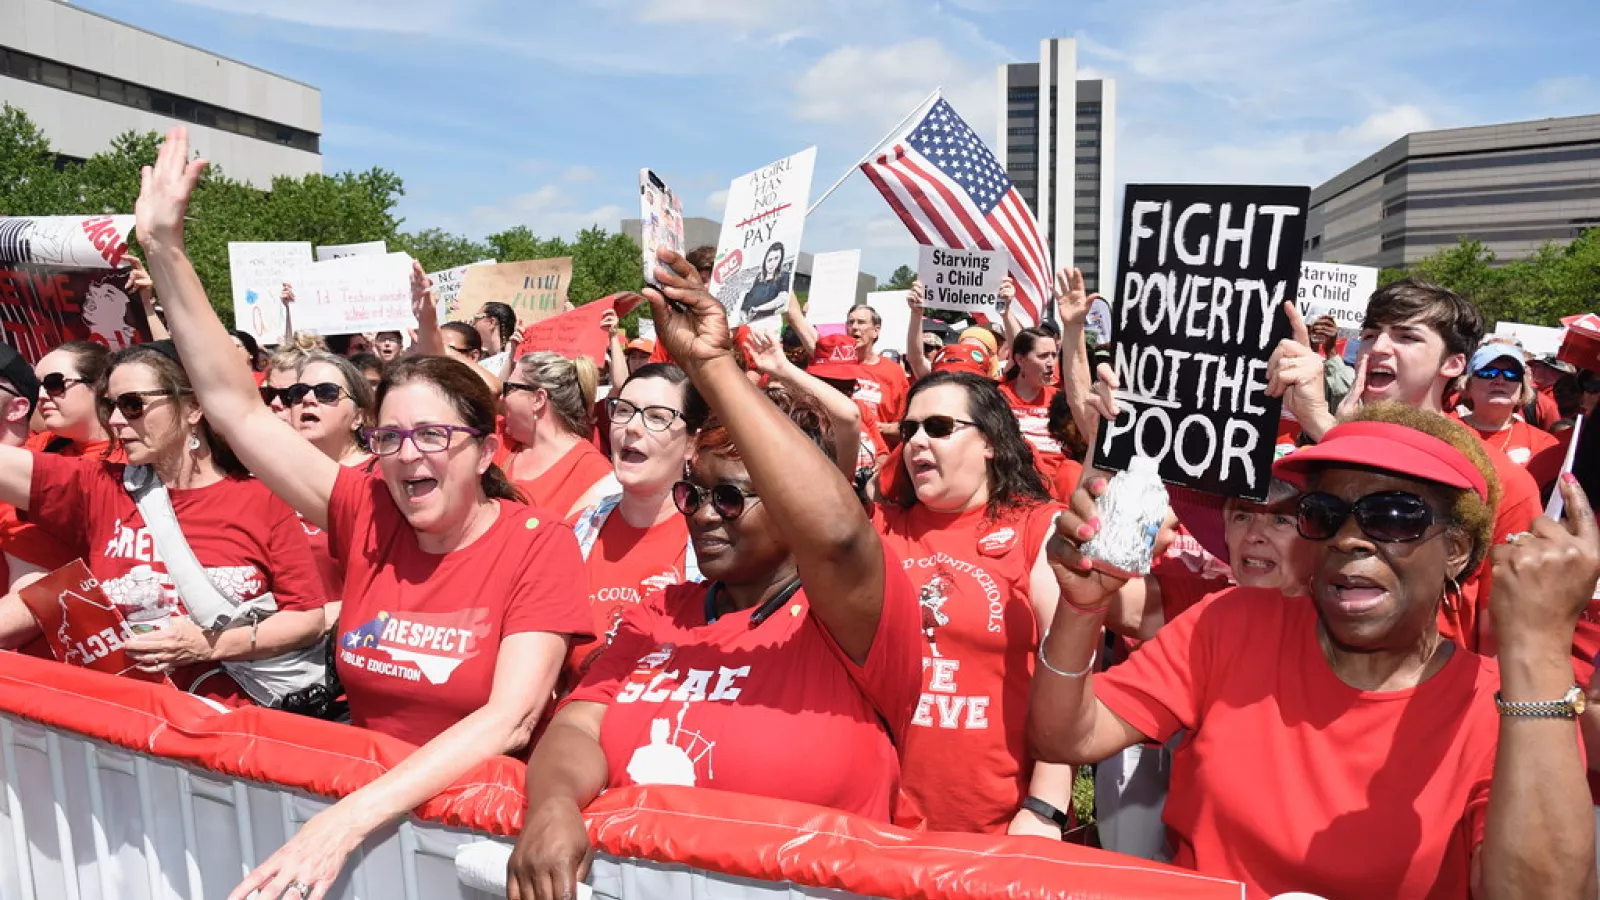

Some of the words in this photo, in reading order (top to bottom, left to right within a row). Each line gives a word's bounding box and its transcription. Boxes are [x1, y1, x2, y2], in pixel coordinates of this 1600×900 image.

[762, 158, 793, 179] GIRL
[754, 178, 782, 197] HAS
[754, 191, 777, 211] NO
[743, 220, 777, 249] PAY
[1129, 200, 1300, 271] FIGHT
[933, 249, 990, 272] Starving
[33, 273, 80, 313] ME
[936, 271, 944, 284] a
[948, 270, 984, 287] Child
[1298, 286, 1307, 298] a
[1312, 284, 1351, 303] Child
[924, 285, 934, 301] is
[938, 287, 996, 305] Violence
[1120, 270, 1287, 350] POVERTY
[1300, 301, 1365, 322] Vence
[1114, 342, 1192, 402] NOT
[1193, 352, 1268, 416] THE
[1102, 400, 1260, 489] POOR
[918, 552, 977, 573] COUNTY
[971, 568, 1004, 633] SCHOOLS
[381, 617, 473, 655] RESPECT
[340, 648, 365, 669] PUBLIC
[366, 657, 421, 682] EDUCATION
[616, 665, 751, 703] SCAE
